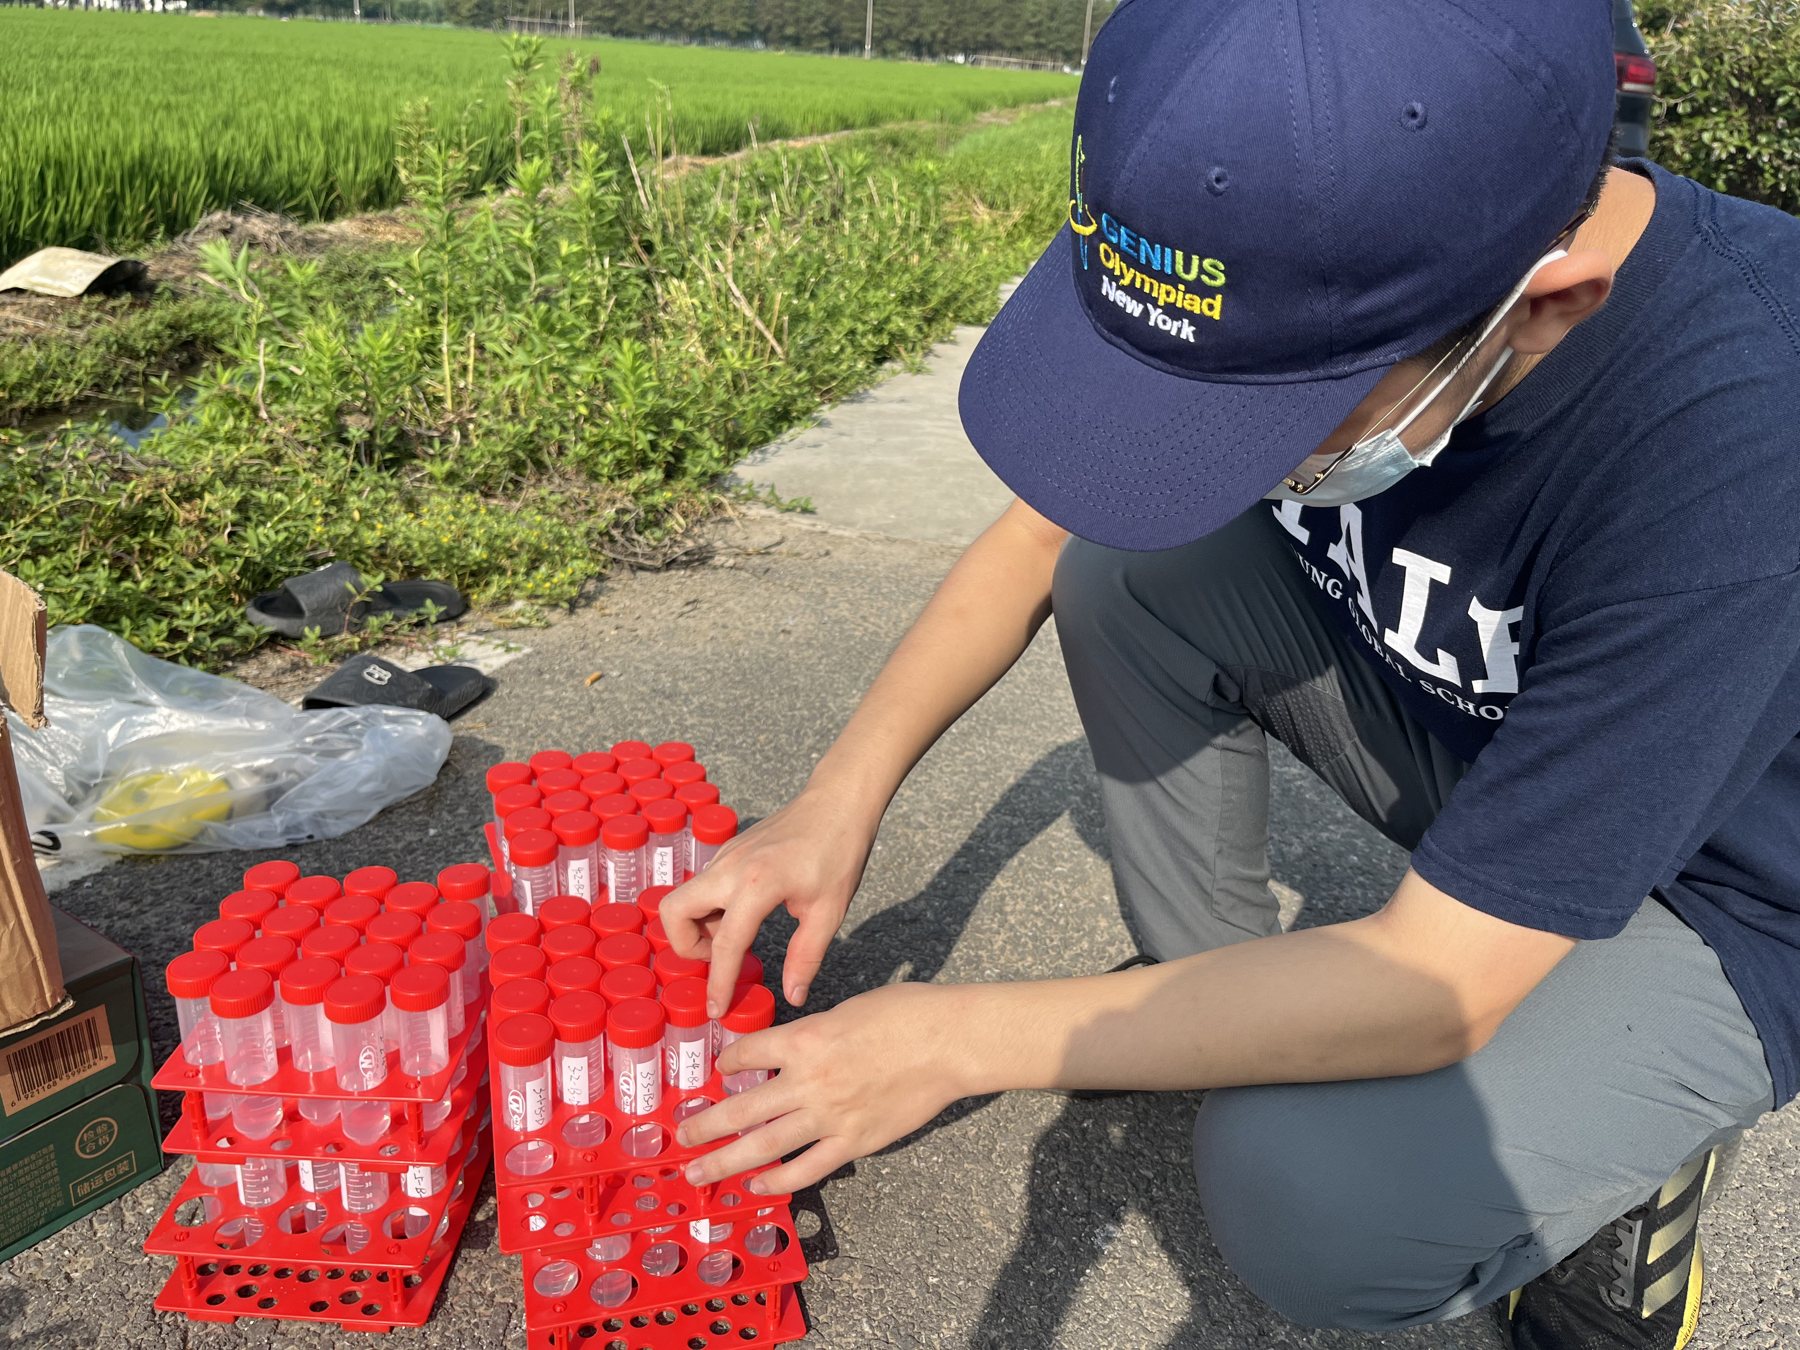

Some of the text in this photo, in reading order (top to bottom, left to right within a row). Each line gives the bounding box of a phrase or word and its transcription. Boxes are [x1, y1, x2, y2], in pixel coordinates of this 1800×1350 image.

[1099, 242, 1223, 320] Olympiad
[1101, 212, 1226, 287] GENIUS
[1101, 275, 1197, 342] New York
[1289, 543, 1509, 721] UNG GLOBAL SCHO
[24, 1081, 58, 1100] 921168
[66, 1061, 98, 1081] 599264
